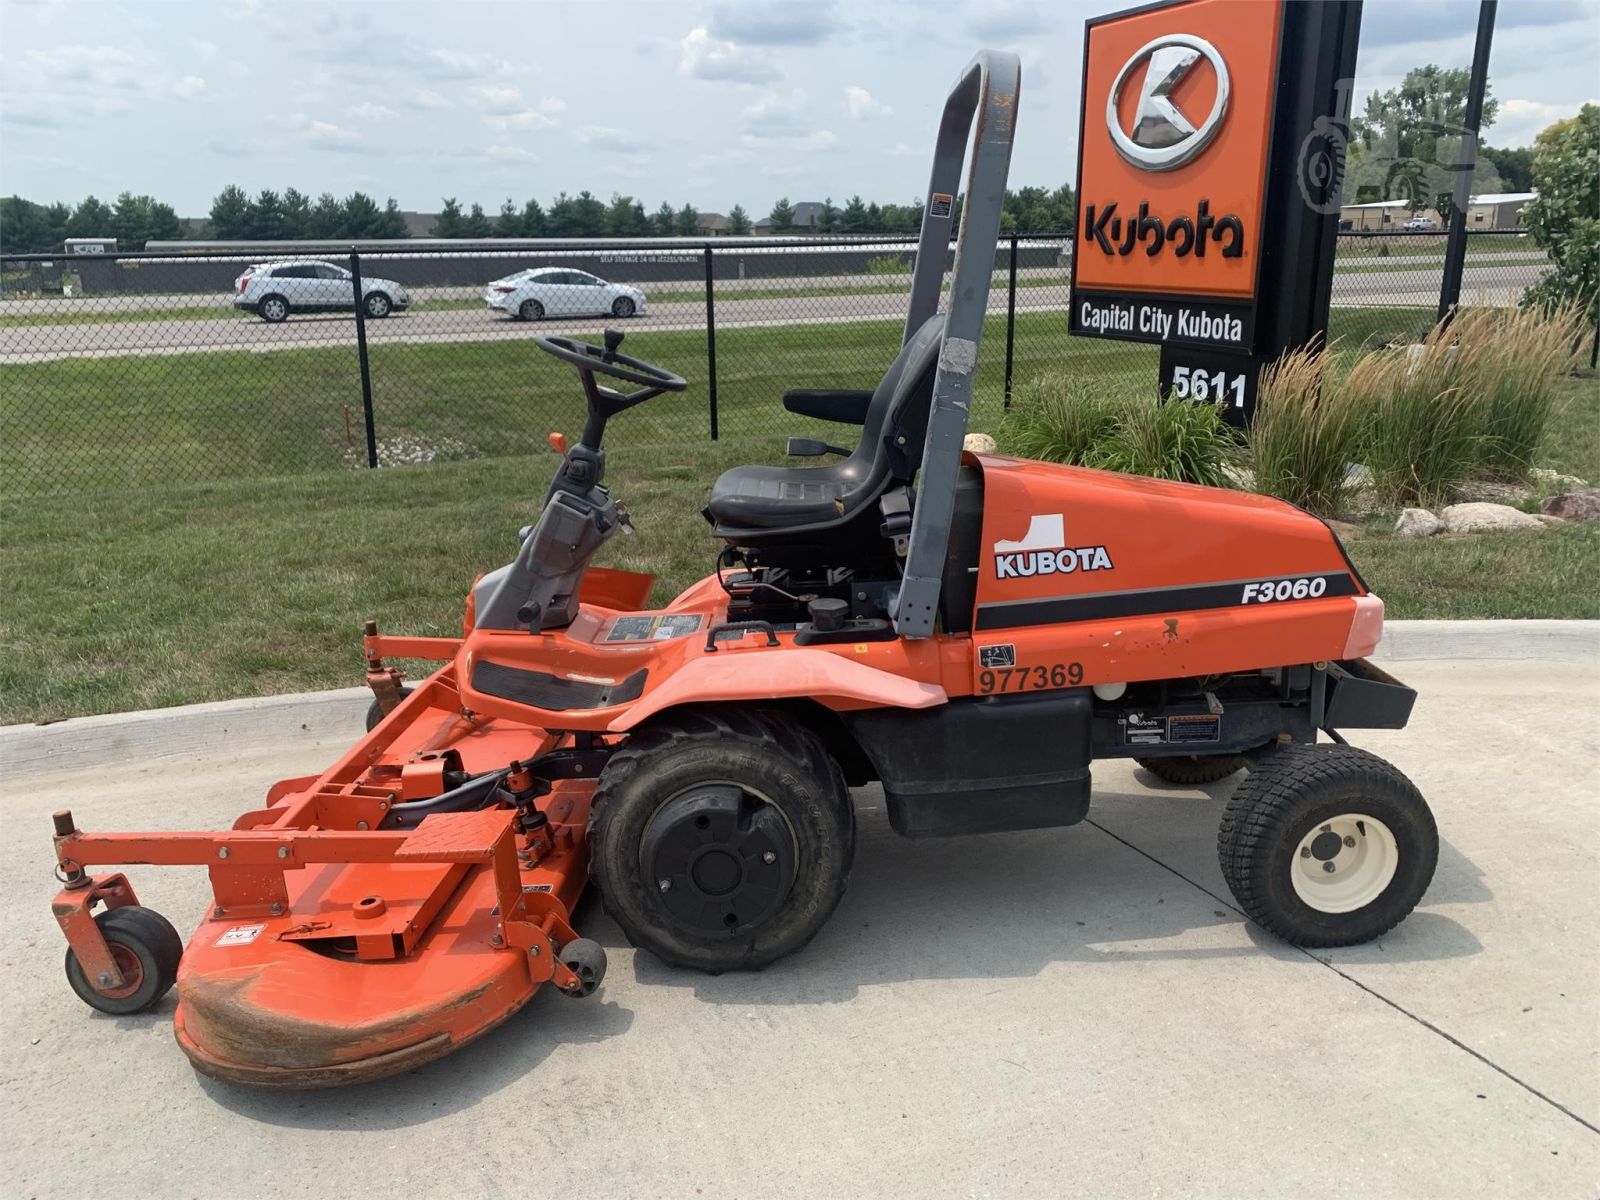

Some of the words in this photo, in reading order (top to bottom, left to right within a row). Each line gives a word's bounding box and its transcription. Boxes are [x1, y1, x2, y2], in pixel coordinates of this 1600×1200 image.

[1085, 199, 1245, 258] Kubota
[1081, 302, 1134, 334] Capital
[1139, 306, 1172, 340] City
[1177, 309, 1242, 342] Kubota
[1173, 366, 1246, 408] 5611
[995, 546, 1114, 579] KUBOTA
[1241, 577, 1327, 604] F3060
[979, 662, 1084, 694] 977369
